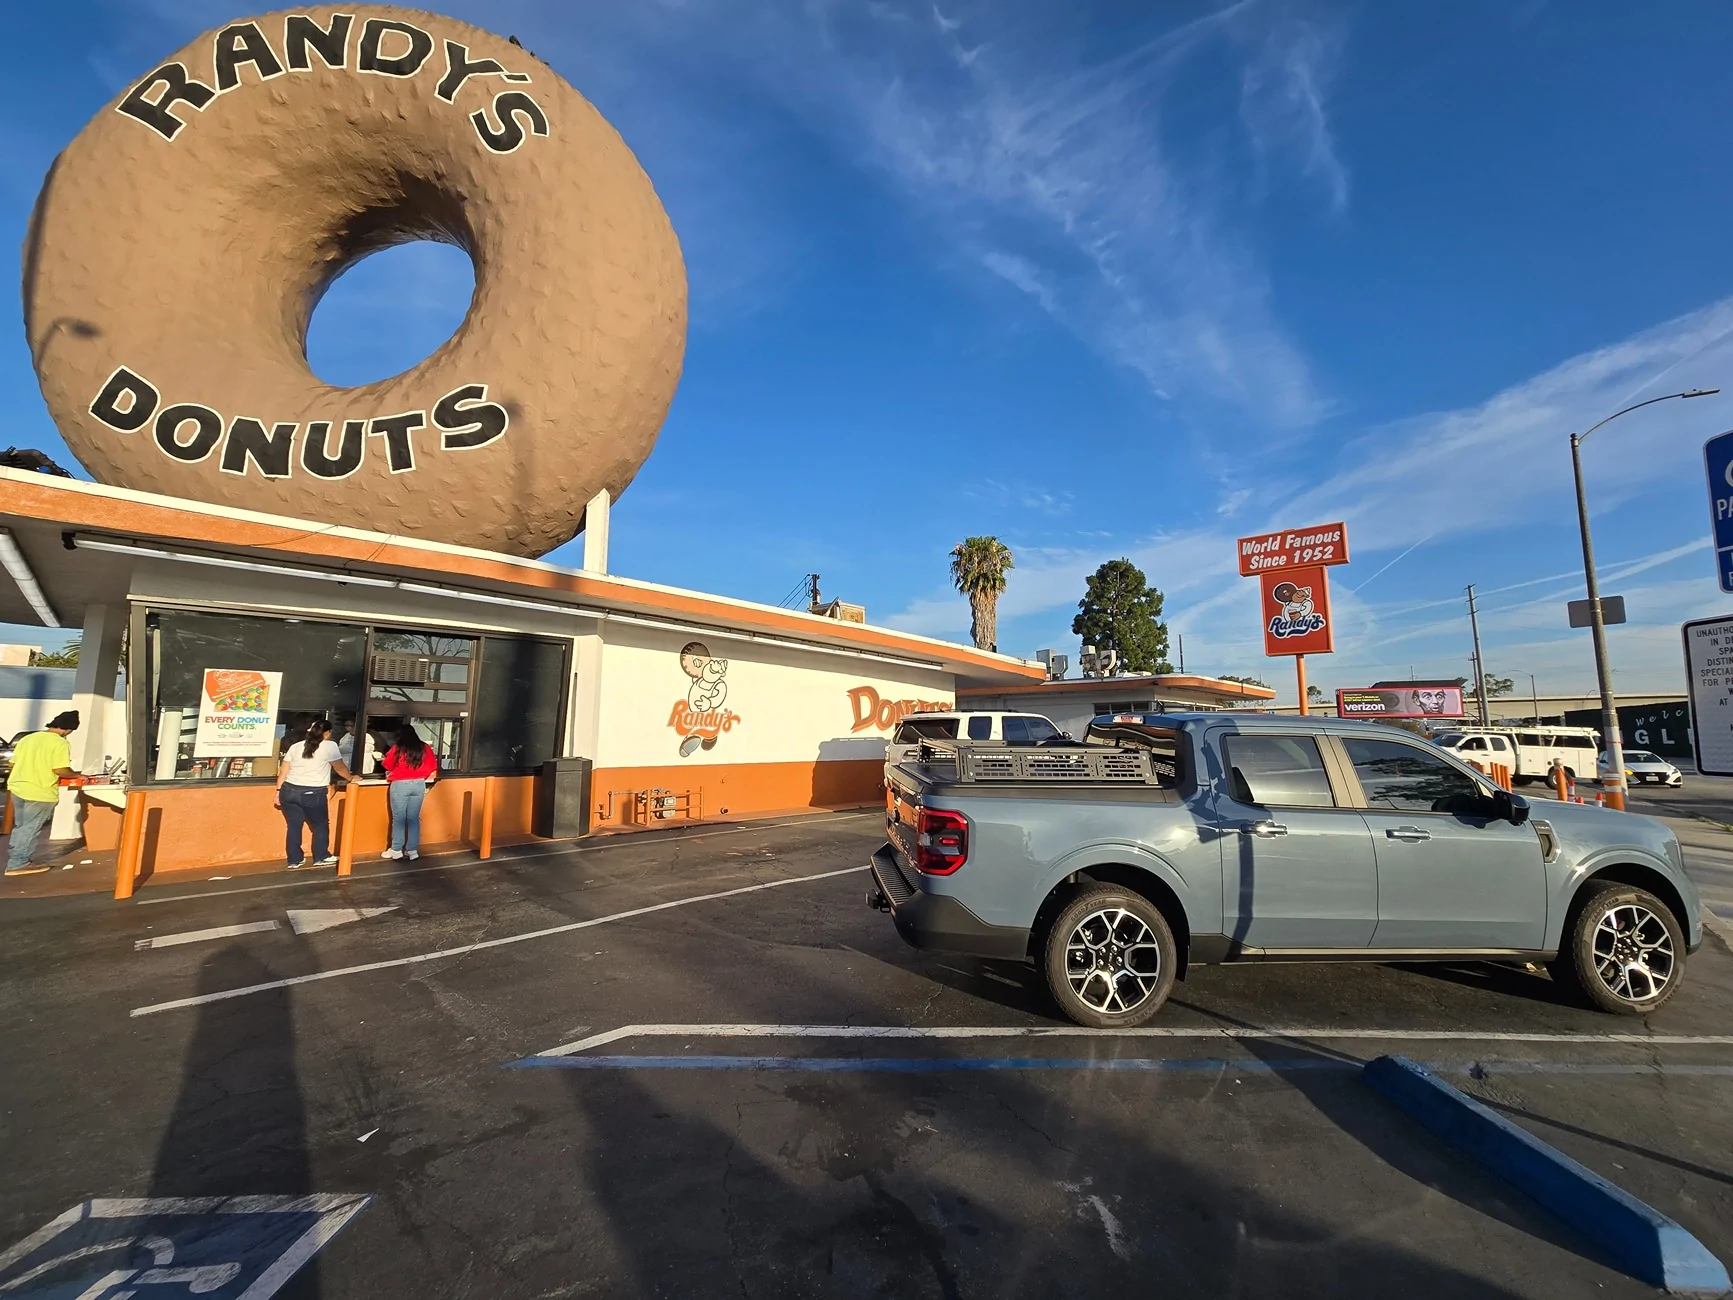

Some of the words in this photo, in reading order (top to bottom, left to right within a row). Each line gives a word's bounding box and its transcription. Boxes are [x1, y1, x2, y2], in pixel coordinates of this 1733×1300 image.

[116, 13, 549, 155] RANDY'S
[88, 366, 509, 479] DONUTS
[1242, 535, 1281, 555] World
[1285, 530, 1340, 549] Famous
[1249, 555, 1287, 569] Since
[1293, 545, 1334, 563] 1952
[1268, 613, 1326, 638] Randy's
[1710, 637, 1719, 646] IN
[1702, 678, 1719, 687] FOR
[1344, 702, 1386, 711] verizon
[1719, 698, 1728, 706] AT
[666, 699, 741, 739] Randy's
